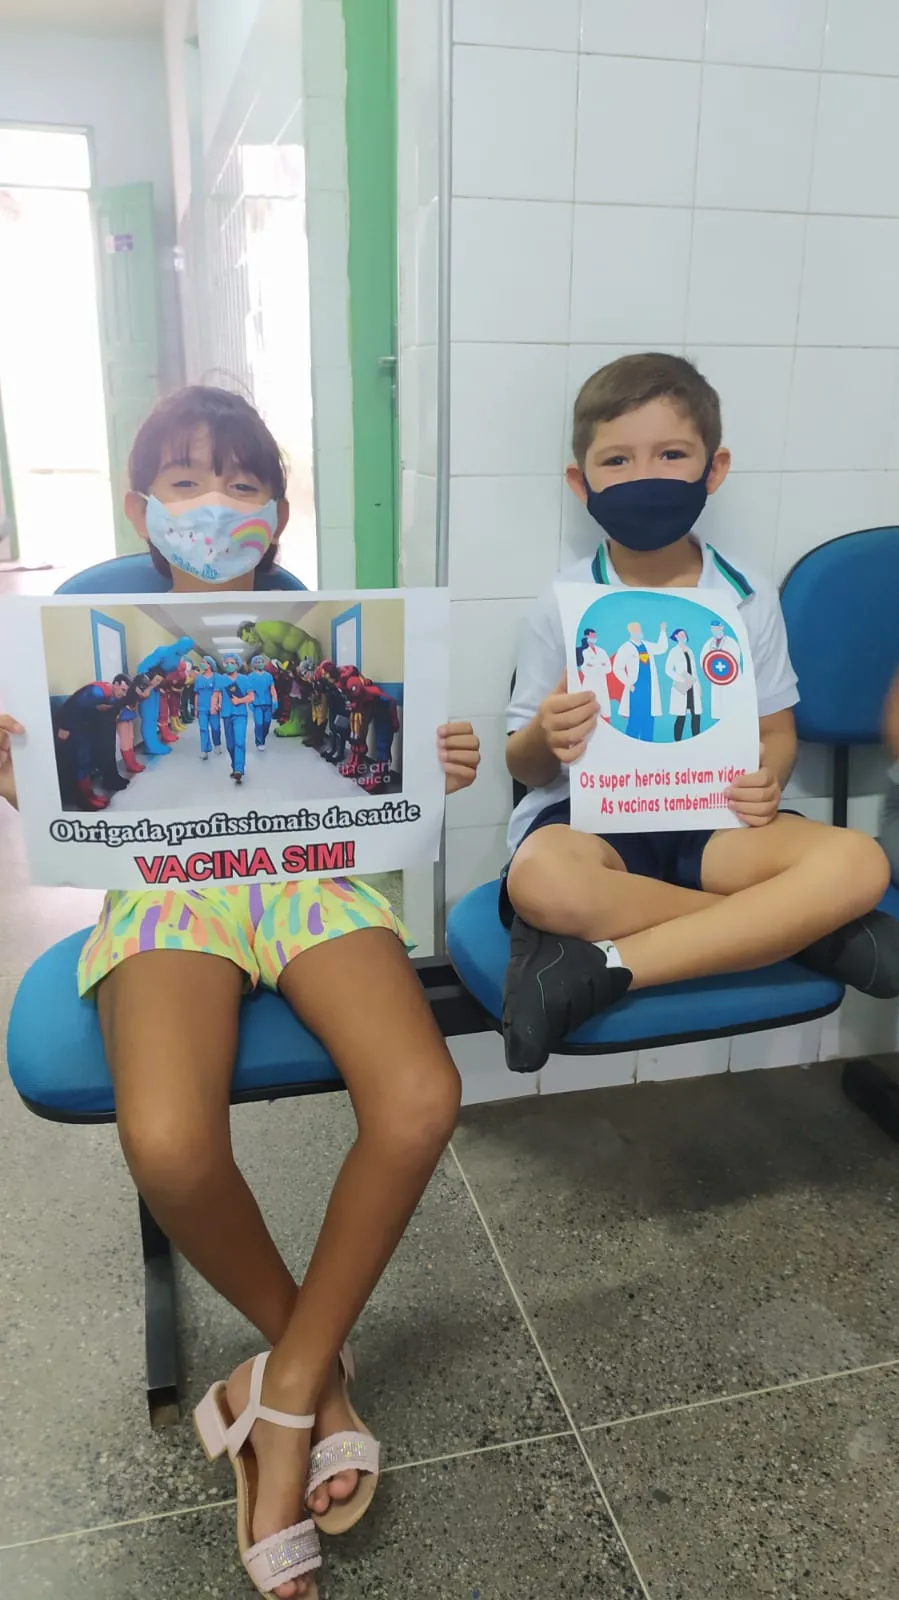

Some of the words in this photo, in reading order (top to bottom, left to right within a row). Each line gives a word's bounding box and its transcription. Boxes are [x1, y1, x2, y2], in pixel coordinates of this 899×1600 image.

[579, 771, 595, 789] Os
[599, 773, 631, 793] super
[675, 767, 714, 786] salvam
[600, 796, 614, 815] As
[618, 796, 660, 814] vacinas
[50, 818, 167, 848] Obrigada
[167, 807, 321, 846] profissionais
[322, 805, 355, 829] da
[355, 800, 421, 827] saúde
[133, 847, 278, 885] VACINA
[281, 840, 356, 874] SIM!
